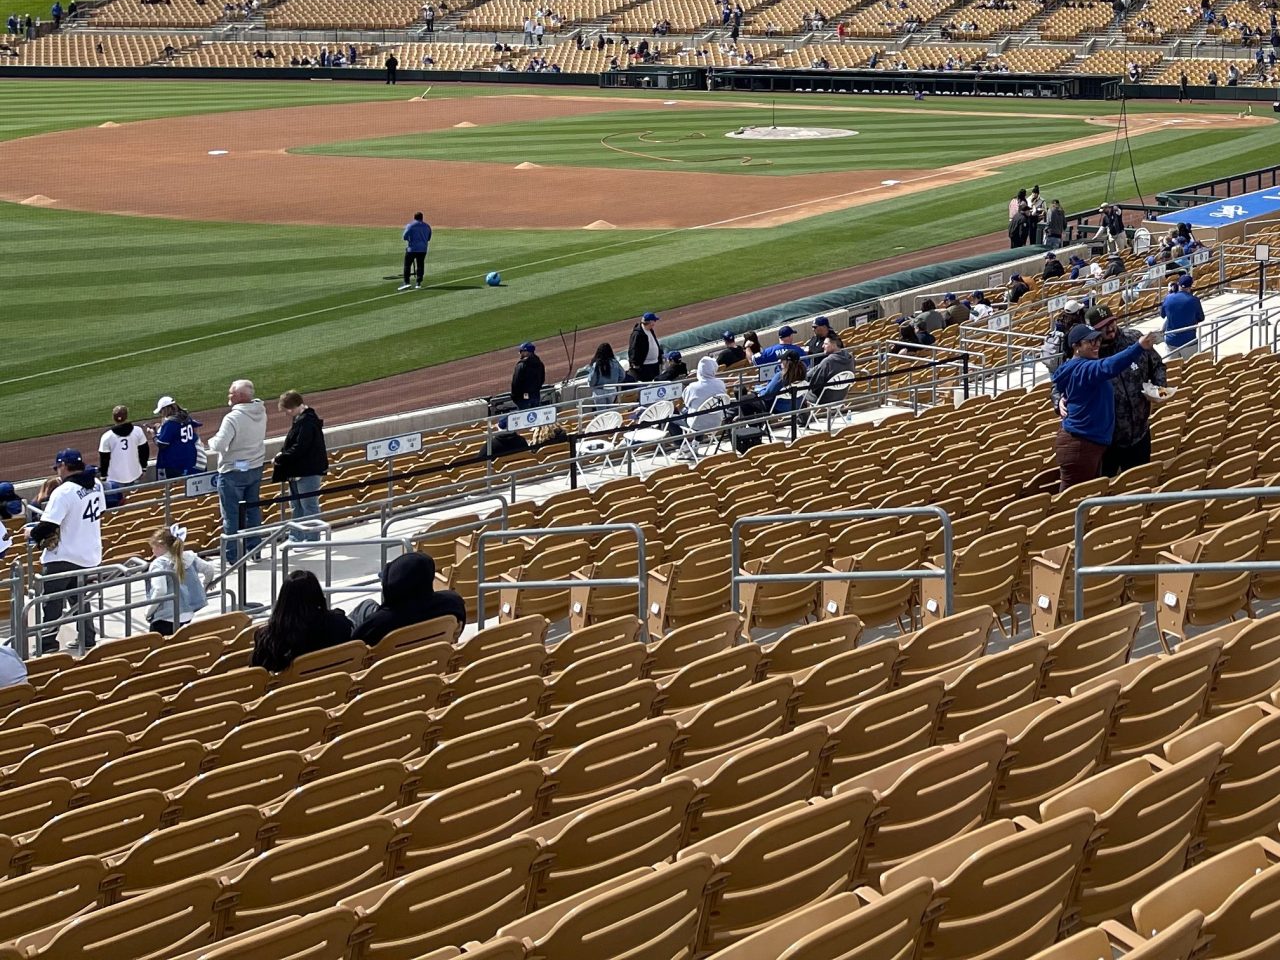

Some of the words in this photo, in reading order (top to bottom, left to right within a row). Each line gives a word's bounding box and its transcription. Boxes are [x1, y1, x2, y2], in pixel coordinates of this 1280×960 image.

[1096, 307, 1108, 318] LA
[180, 424, 194, 443] 50
[120, 438, 128, 450] 3
[82, 496, 101, 522] 42
